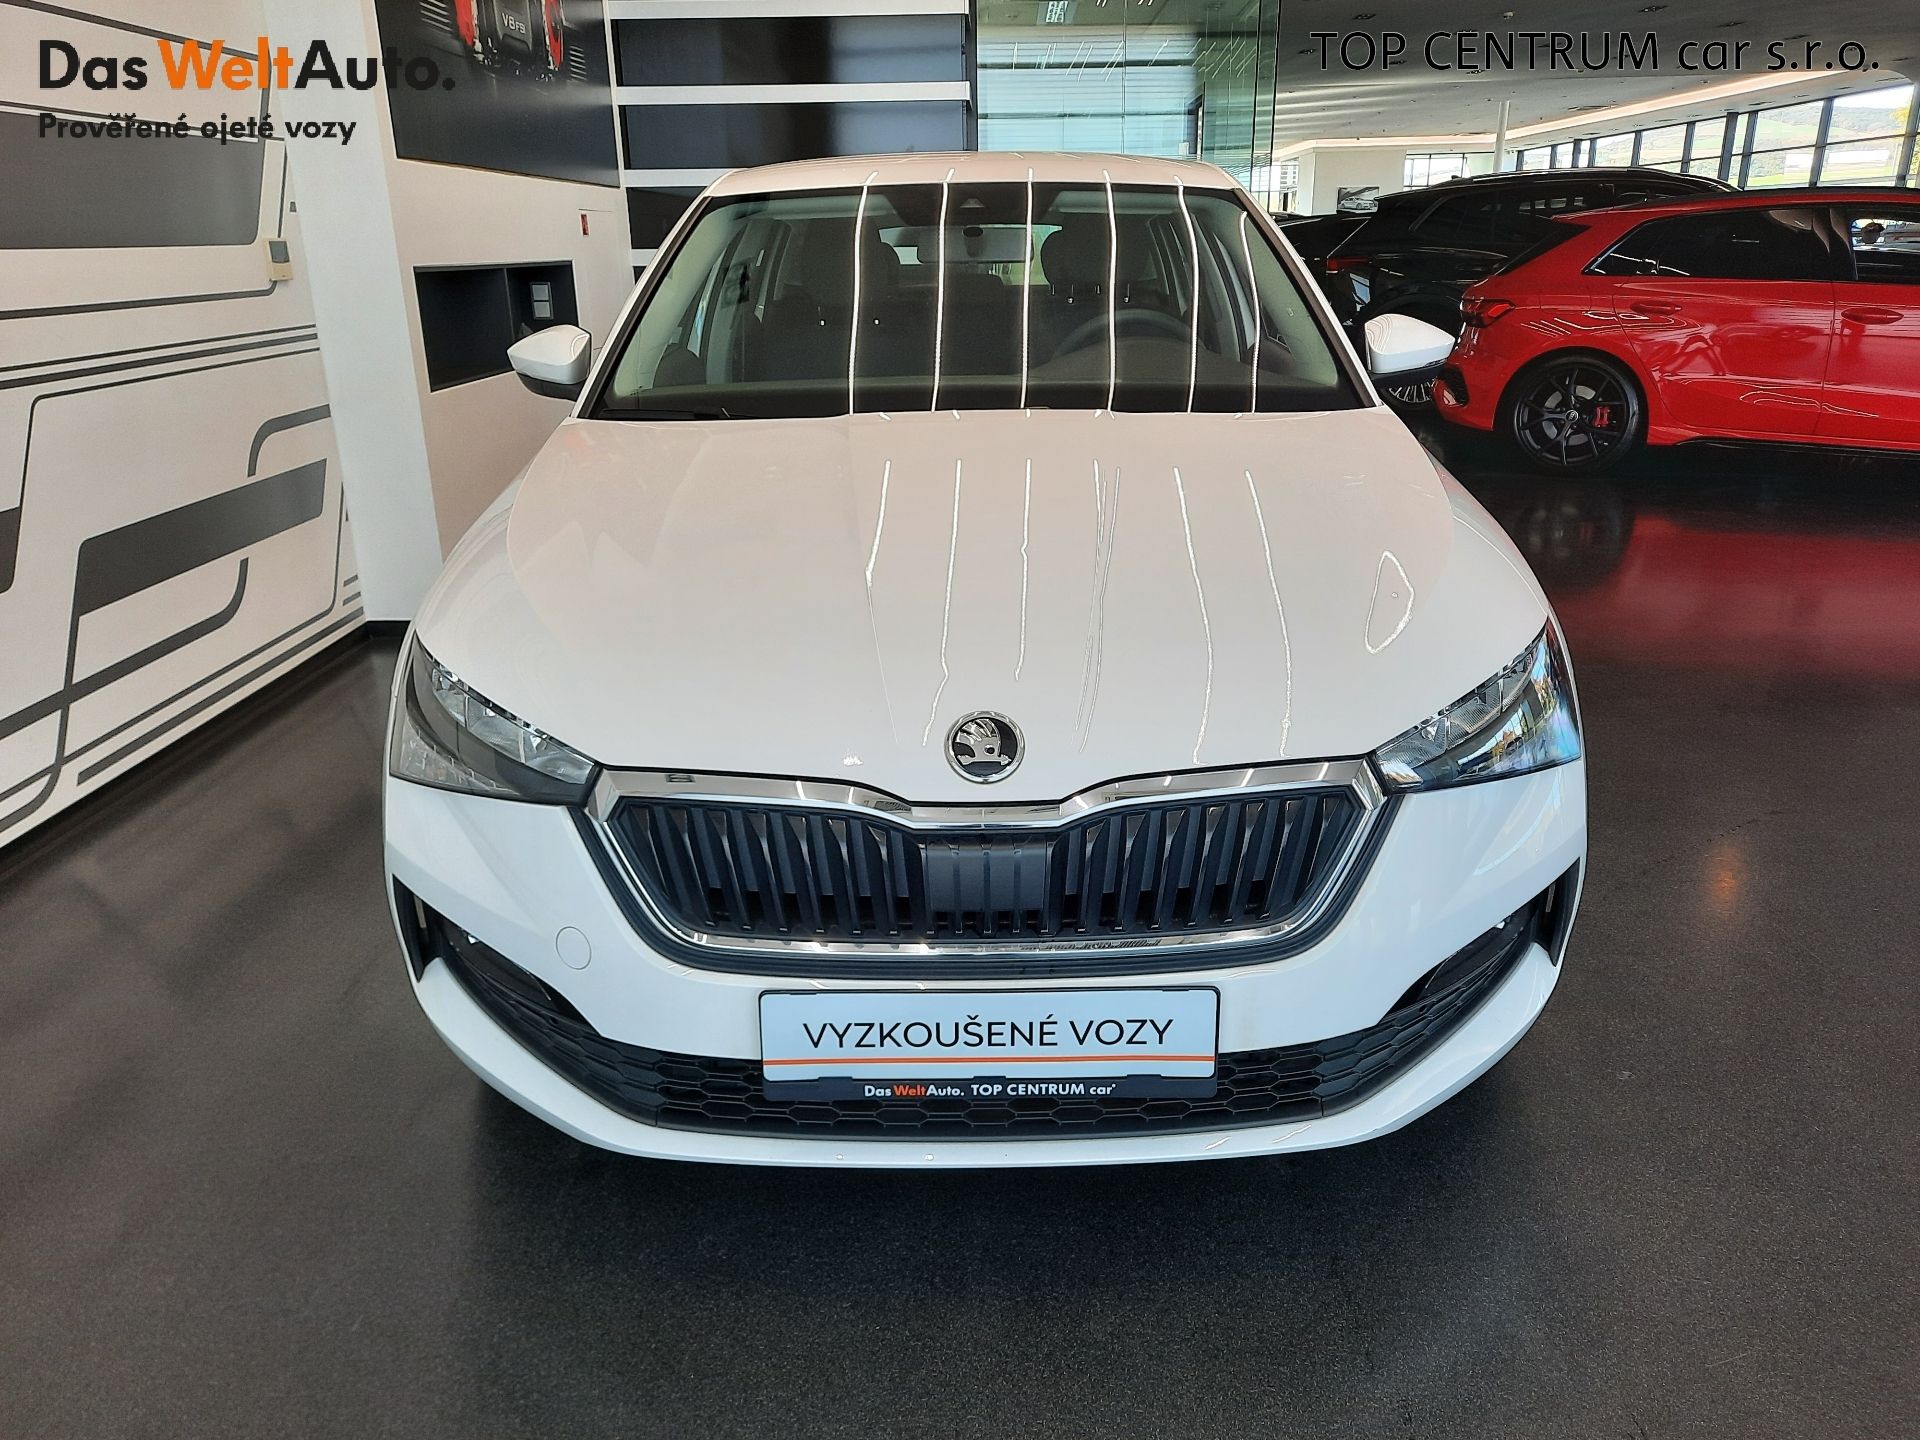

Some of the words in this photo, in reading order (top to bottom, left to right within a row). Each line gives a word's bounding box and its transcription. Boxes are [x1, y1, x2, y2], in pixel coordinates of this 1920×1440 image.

[802, 1013, 1059, 1049] VYZKOUŠENÉ
[1068, 1018, 1175, 1046] VOZY
[970, 1083, 1003, 1097] TOP
[1006, 1082, 1086, 1096] CENTRUM
